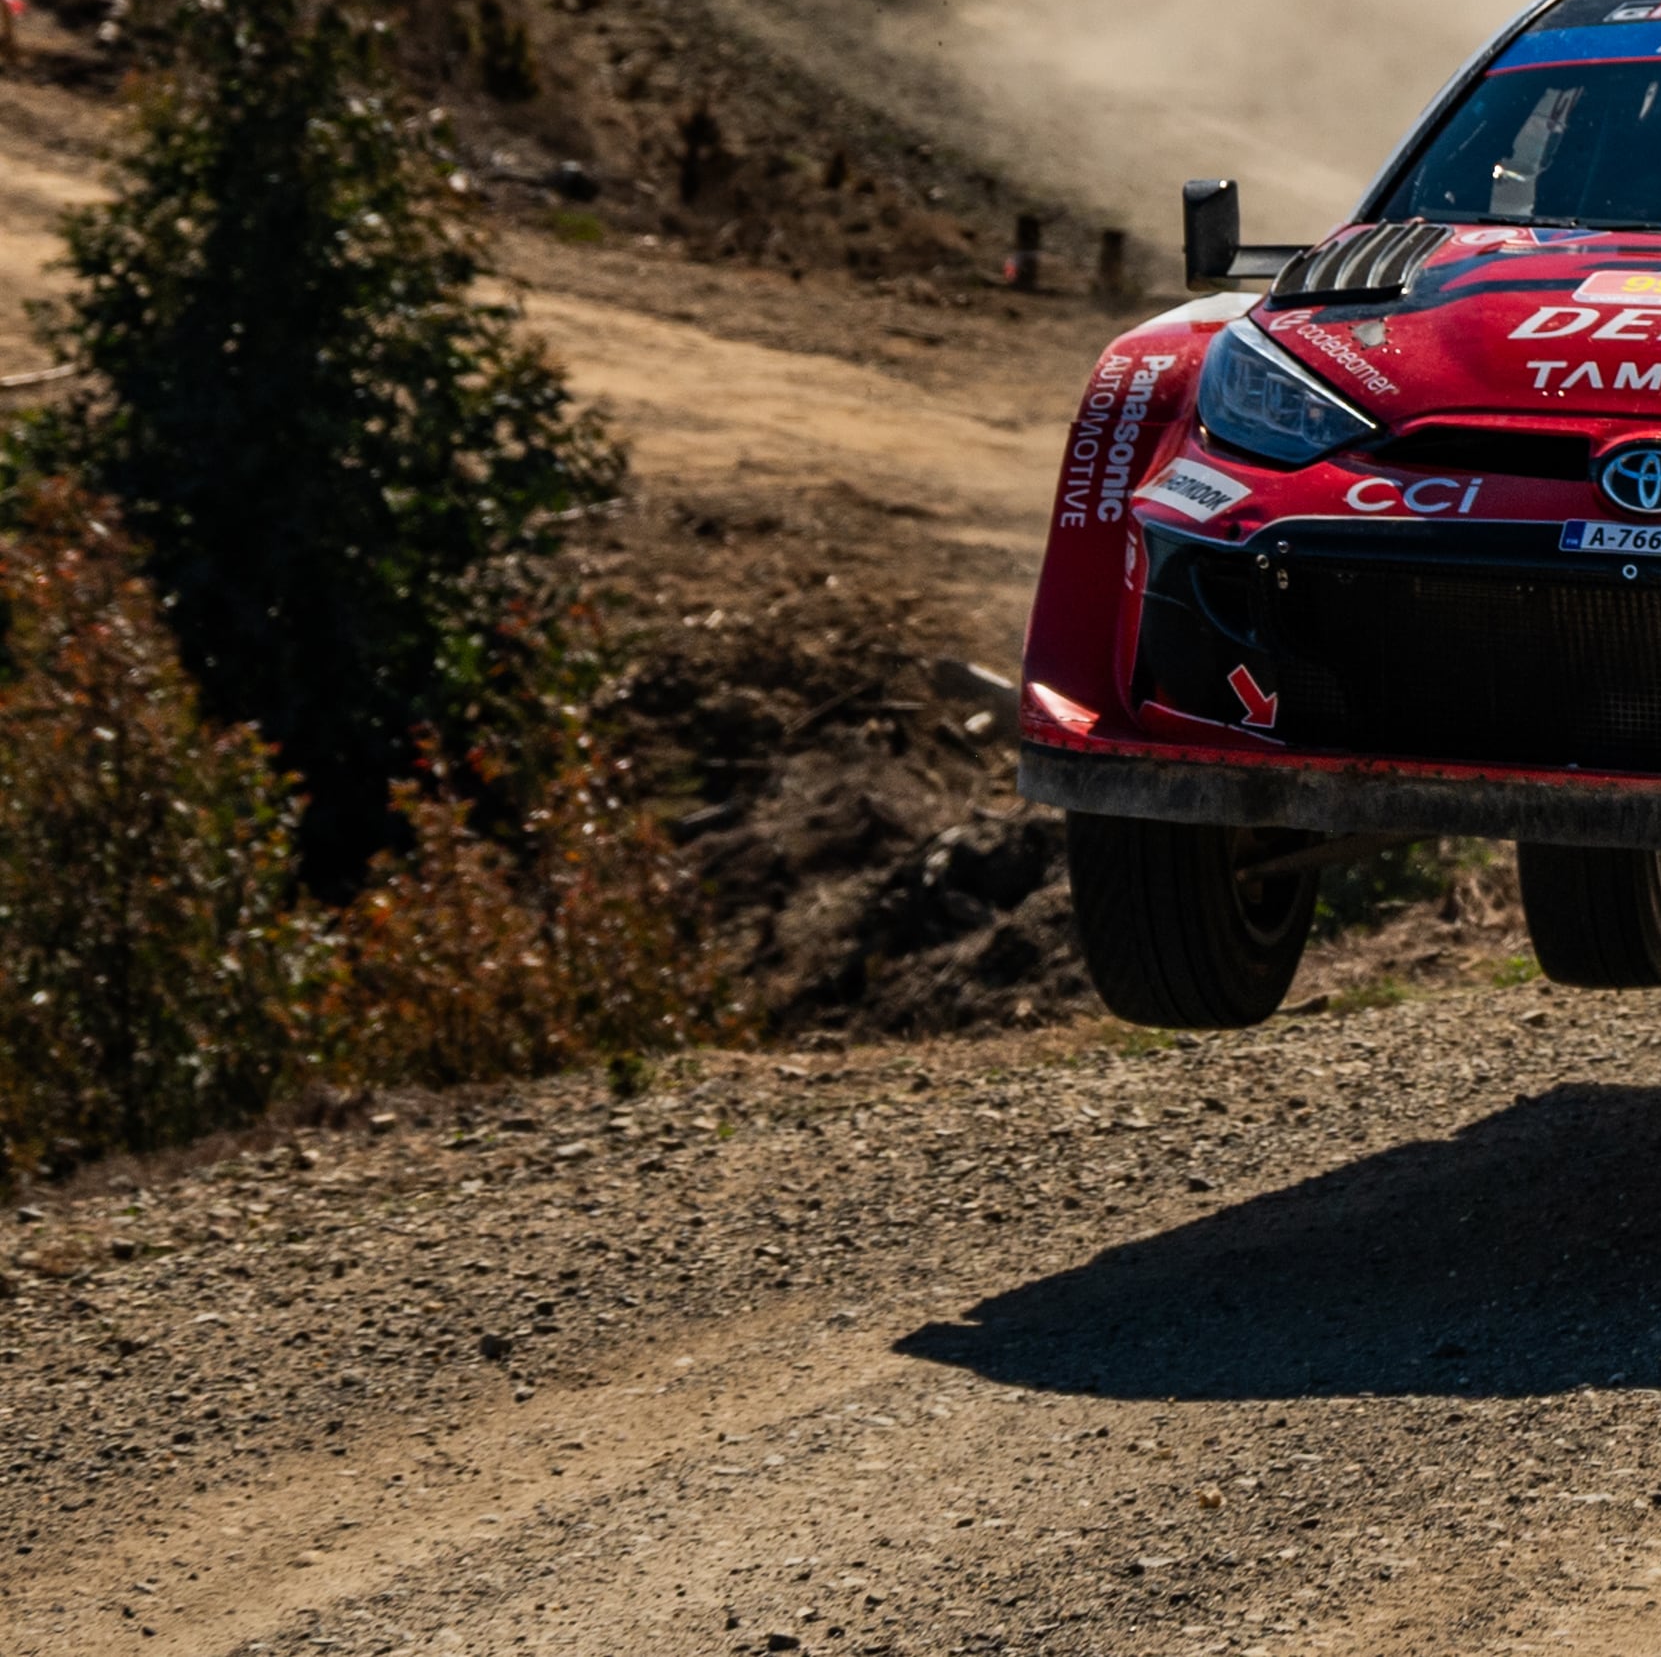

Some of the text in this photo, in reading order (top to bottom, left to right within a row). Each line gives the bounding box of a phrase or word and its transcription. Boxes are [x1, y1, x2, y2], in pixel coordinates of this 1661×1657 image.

[1060, 354, 1133, 528] AUTOMOTIVE
[1097, 354, 1177, 523] Panasonic
[1296, 322, 1399, 395] codebeamer
